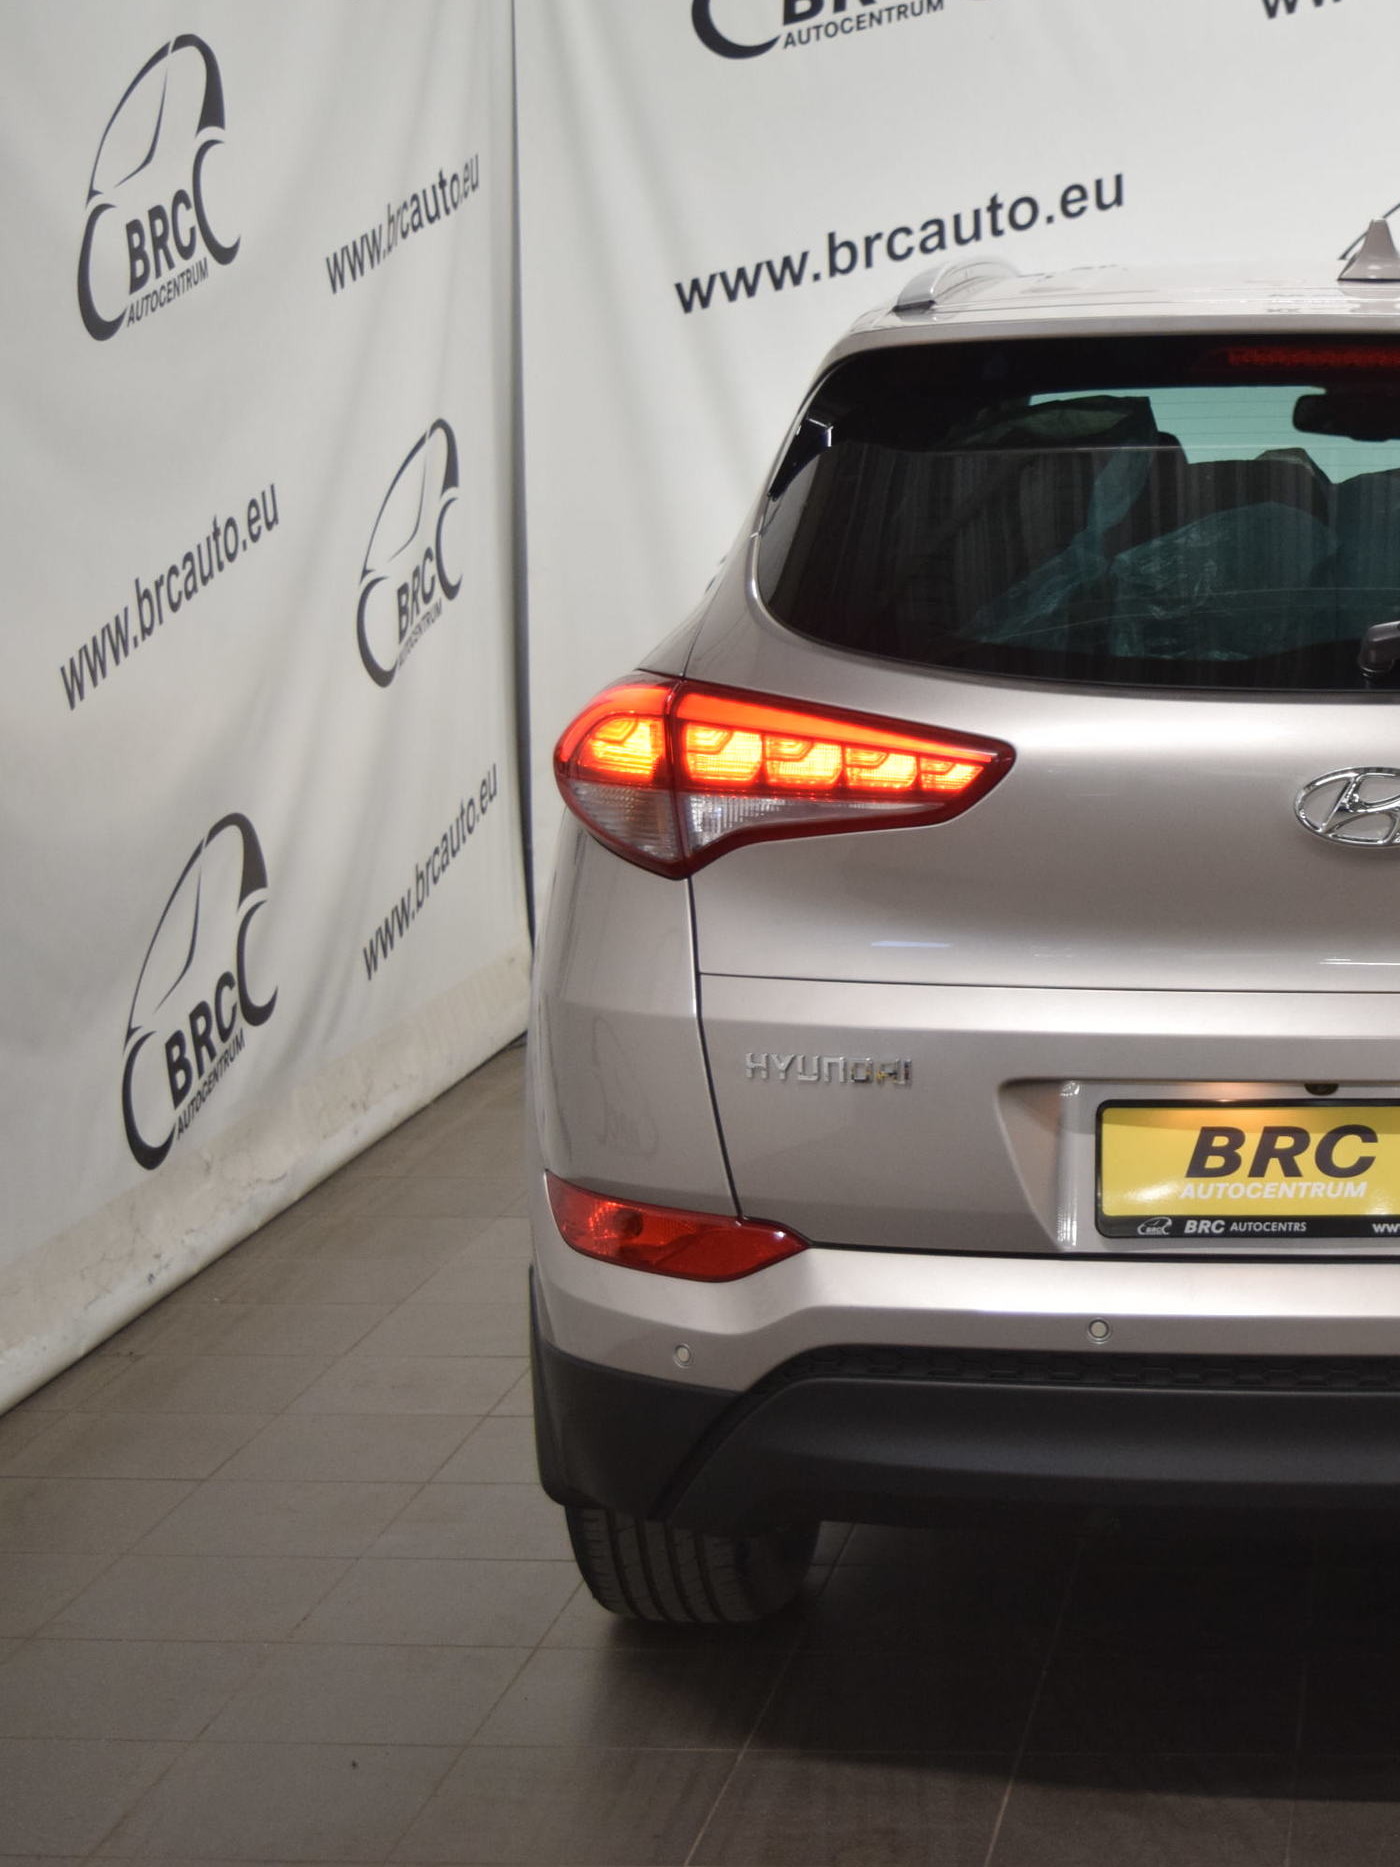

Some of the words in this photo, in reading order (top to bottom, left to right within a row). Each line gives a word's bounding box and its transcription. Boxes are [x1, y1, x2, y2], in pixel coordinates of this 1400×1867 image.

[783, 0, 944, 49] AUTOCENTRUM
[126, 189, 197, 295] BRC
[325, 154, 479, 295] www.brcauto.eu
[674, 173, 1124, 315] www.brcauto.eu
[126, 258, 209, 327] AUTOCENTRUM
[59, 483, 280, 711] www.brcauto.eu
[397, 546, 436, 645] BRC
[363, 763, 498, 982] www.brcauto.eu
[164, 972, 238, 1110] BRC
[175, 1030, 245, 1140] AUTOCENTRUM
[745, 1052, 912, 1084] HYUNDAI
[1180, 1181, 1367, 1200] AUTOCENTRUM
[1185, 1124, 1379, 1178] BRC
[1184, 1219, 1226, 1234] BRC
[1230, 1221, 1307, 1232] AUTOCENTRS
